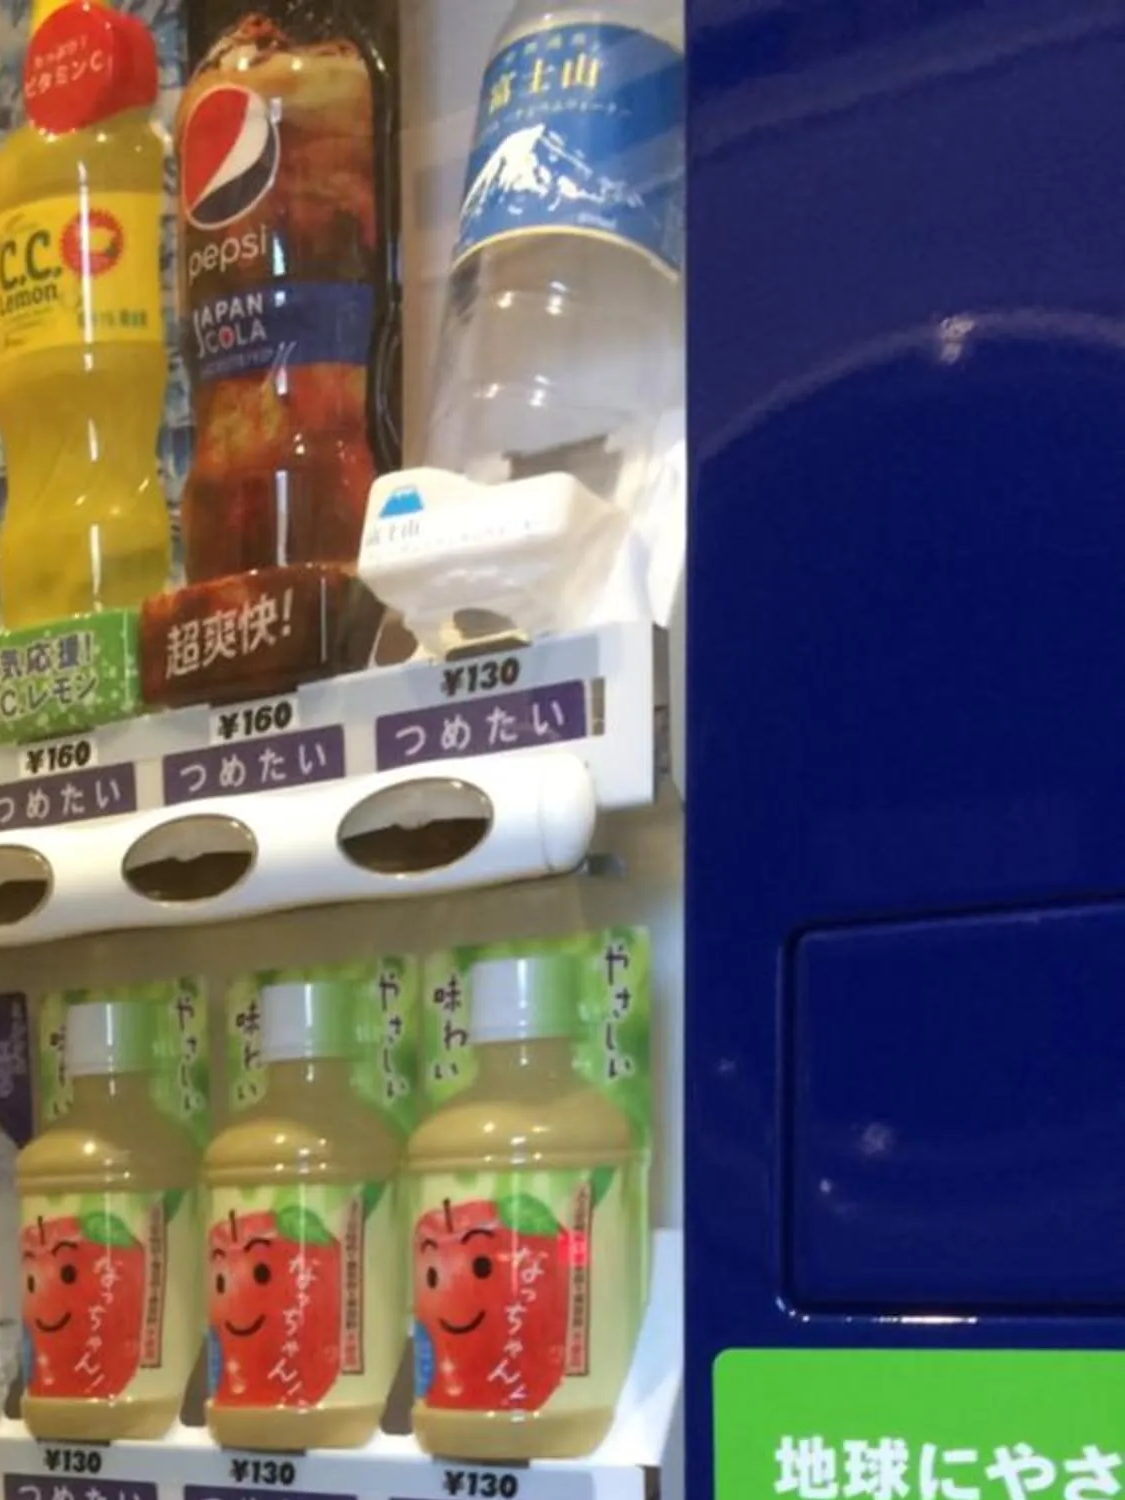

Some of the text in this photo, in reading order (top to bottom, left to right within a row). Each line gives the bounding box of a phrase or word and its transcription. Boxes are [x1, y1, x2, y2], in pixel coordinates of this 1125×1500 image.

[189, 223, 267, 286] pepsi
[0, 283, 58, 318] Lemon
[193, 292, 264, 359] JAPAN
[205, 318, 267, 353] COLA
[165, 588, 294, 679] 超爽快!
[442, 657, 520, 697] ¥130
[218, 702, 293, 739] ¥160
[395, 700, 567, 757] つめたい
[27, 741, 92, 773] ¥160
[180, 743, 328, 793] つめたい
[433, 973, 469, 1080] 味わい
[605, 944, 632, 1079] やさしい
[43, 1448, 102, 1474] ¥130
[229, 1458, 297, 1486] ¥130
[443, 1470, 520, 1500] ¥130
